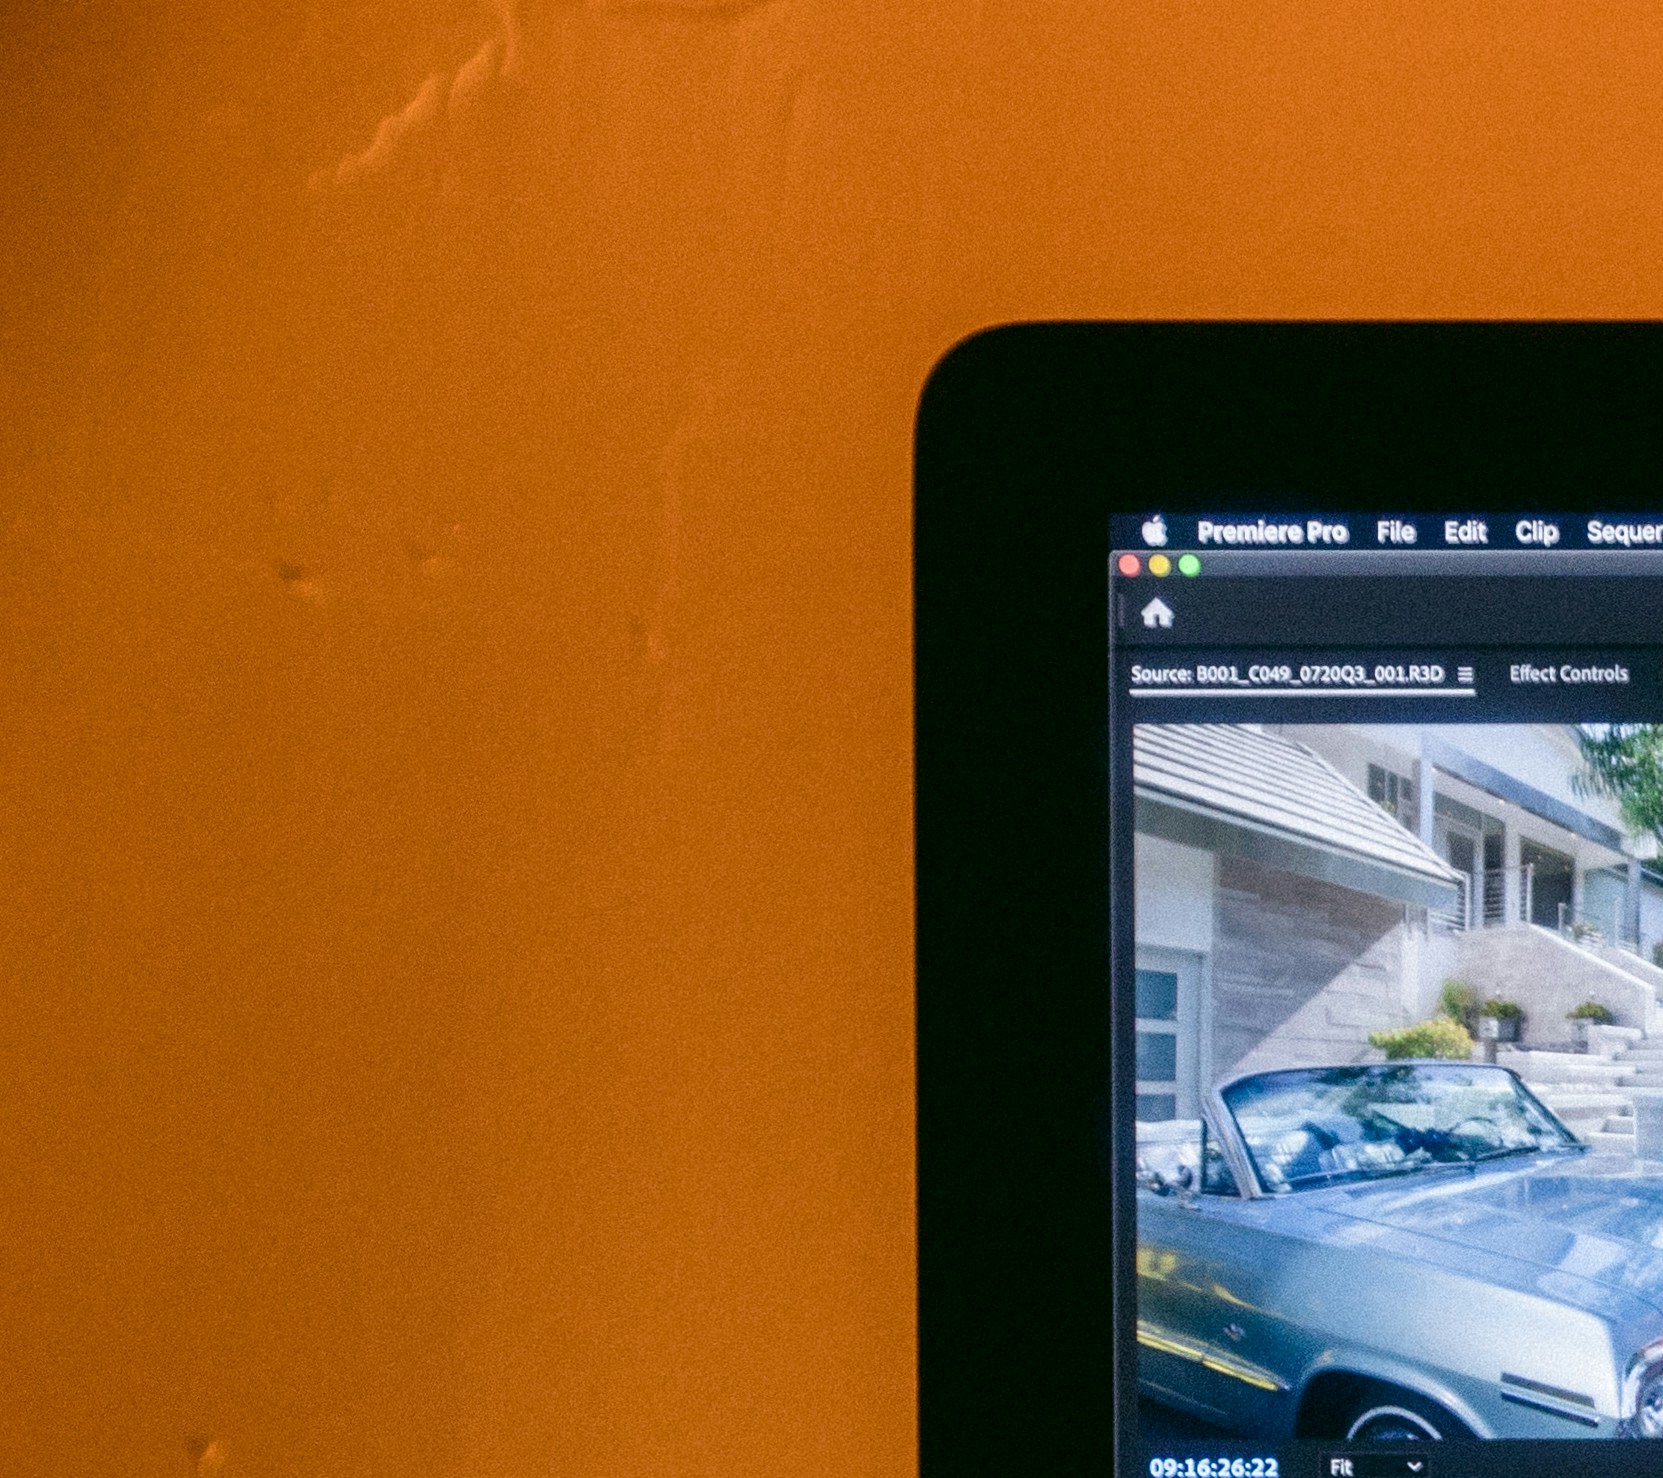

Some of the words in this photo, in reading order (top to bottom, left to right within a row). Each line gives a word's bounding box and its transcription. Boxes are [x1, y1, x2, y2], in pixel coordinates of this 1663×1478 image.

[1197, 519, 1304, 544] Premiere
[1307, 520, 1349, 544] Pro
[1377, 520, 1417, 544] File
[1444, 520, 1488, 544] Edit
[1515, 519, 1560, 547] Clip
[1131, 664, 1192, 684] Source:
[1196, 664, 1445, 685] B001_C049_0720Q3_001.R3D
[1510, 664, 1557, 683] Effect
[1559, 664, 1629, 683] Controls
[1149, 1457, 1278, 1478] 09:16:26:22
[1330, 1458, 1353, 1476] Fit
